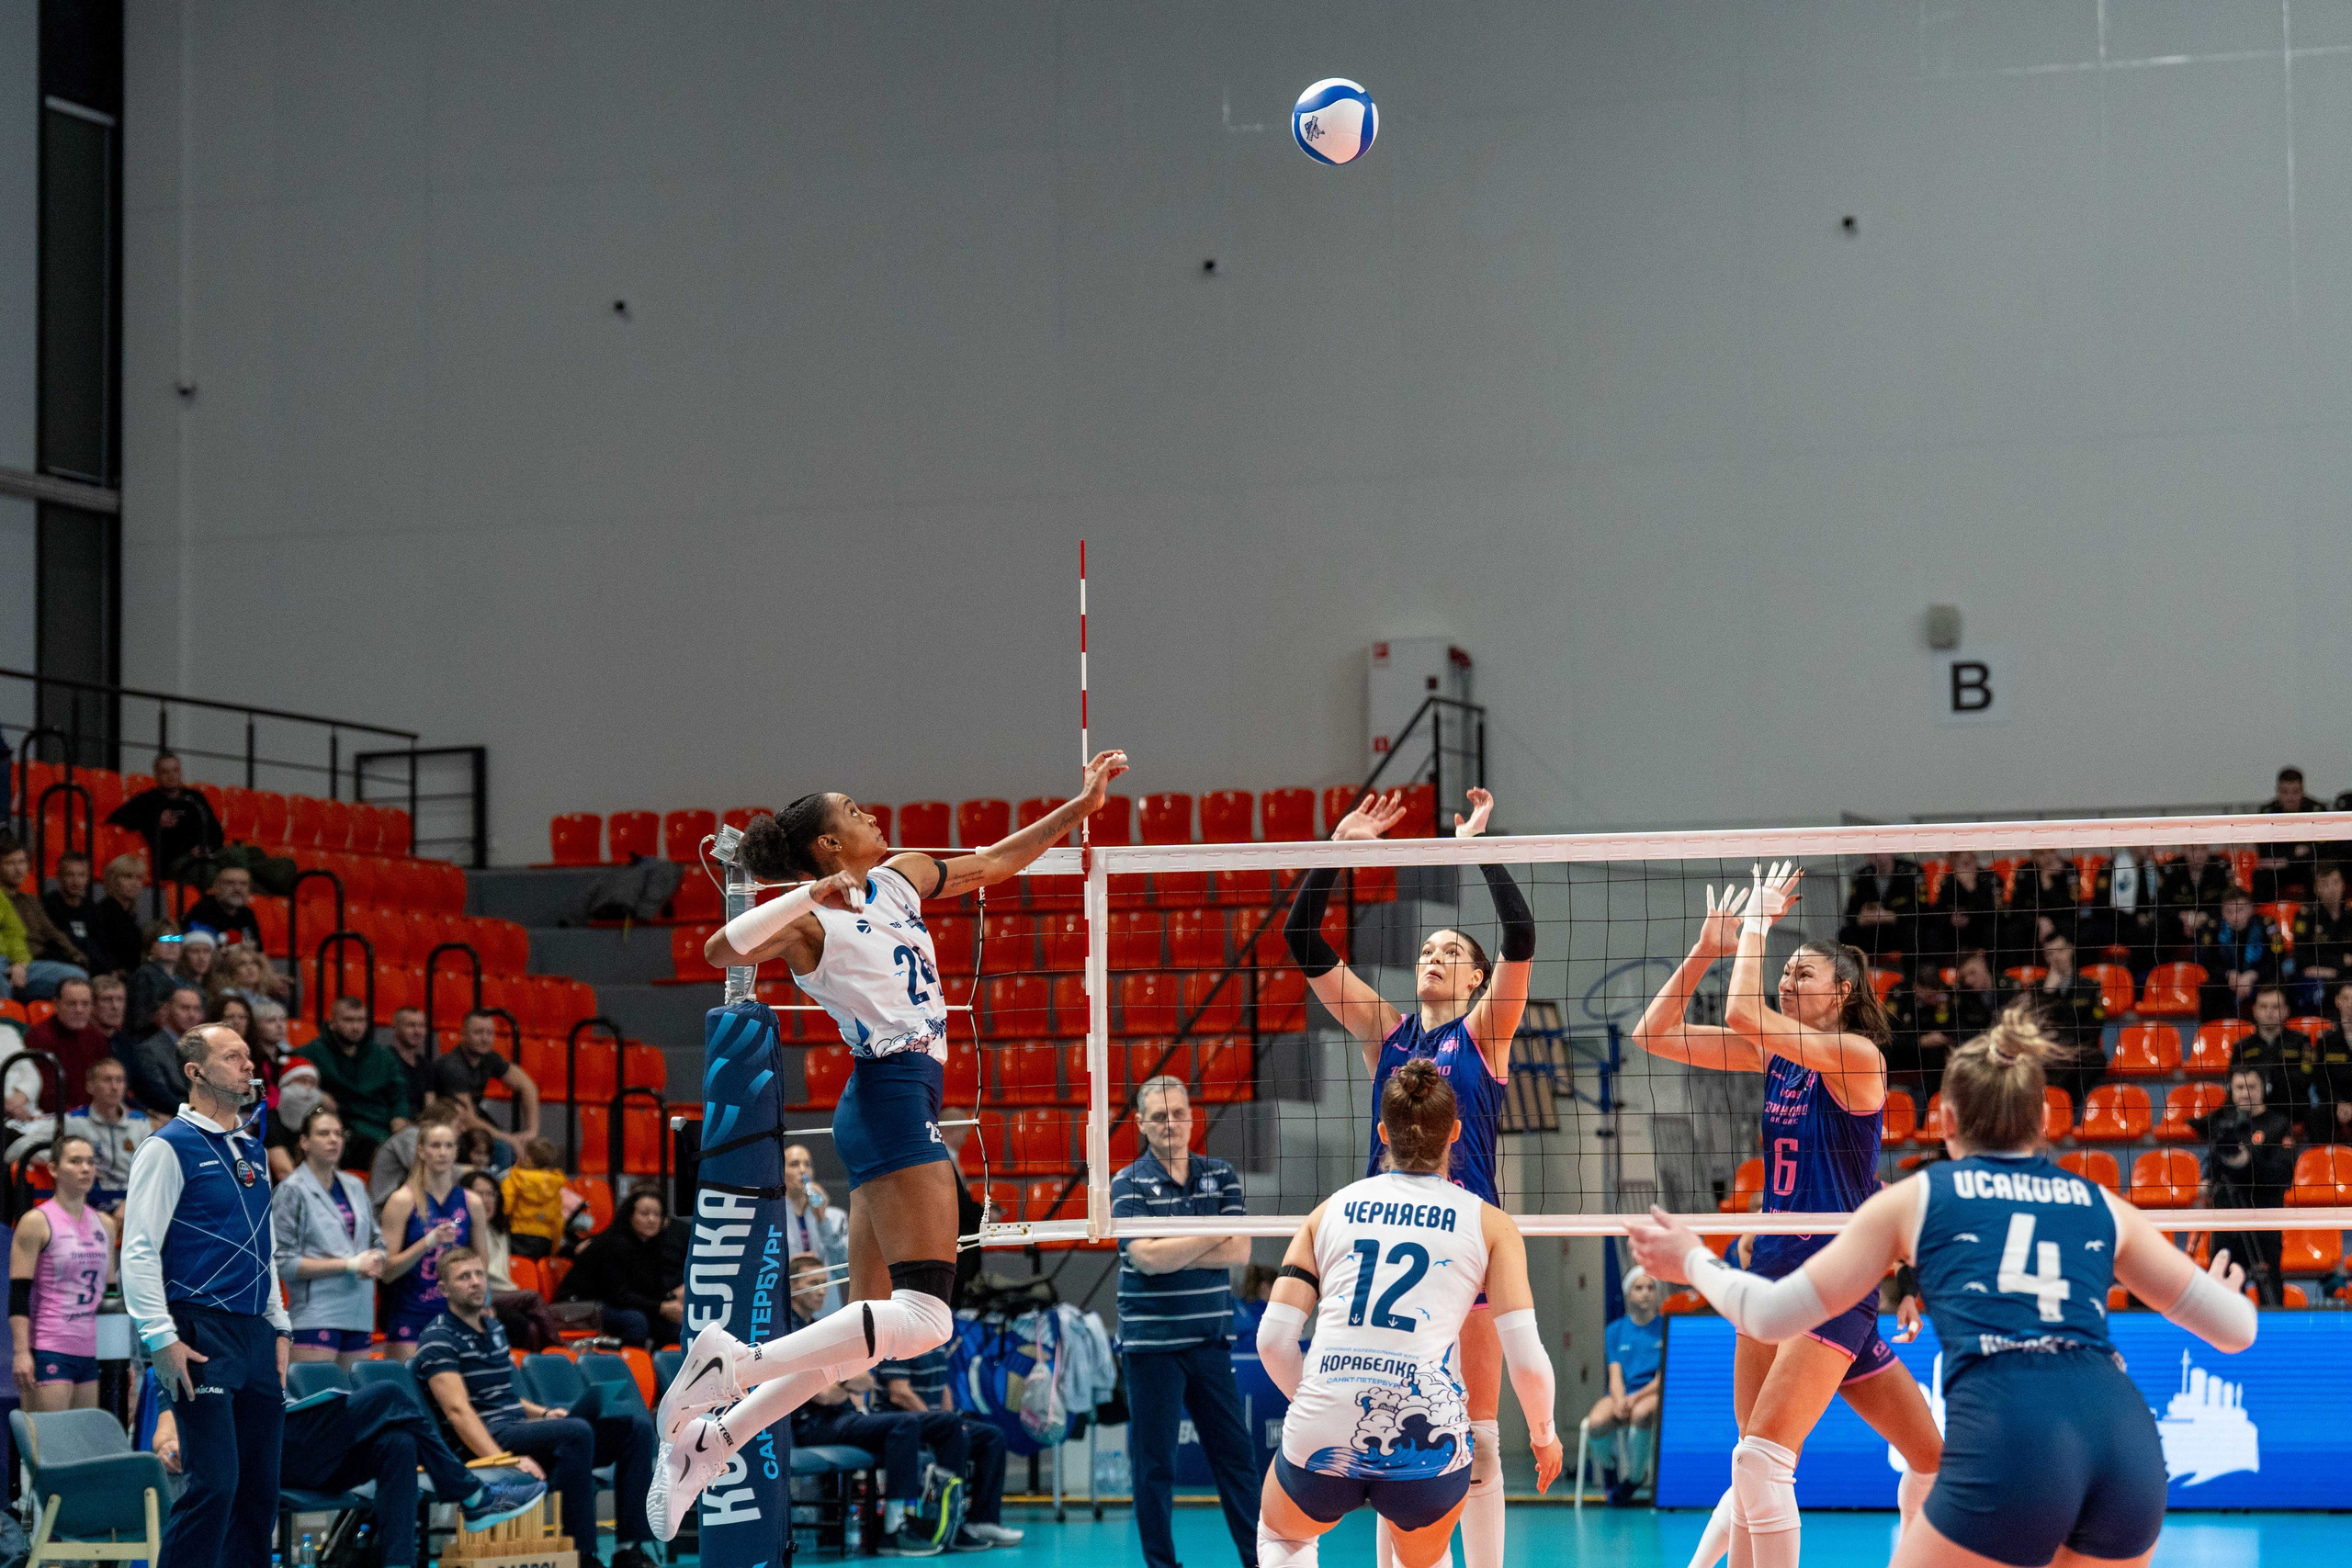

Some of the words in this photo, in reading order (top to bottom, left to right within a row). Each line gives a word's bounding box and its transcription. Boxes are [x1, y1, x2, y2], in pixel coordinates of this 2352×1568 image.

[1773, 1137, 1799, 1197] 6
[1344, 1201, 1457, 1233] ЧЕРНЯЕВА
[77, 1269, 98, 1305] 3
[1348, 1239, 1430, 1333] 12
[1997, 1213, 2071, 1323] 4
[1319, 1354, 1418, 1380] КОРАБЕЛКА
